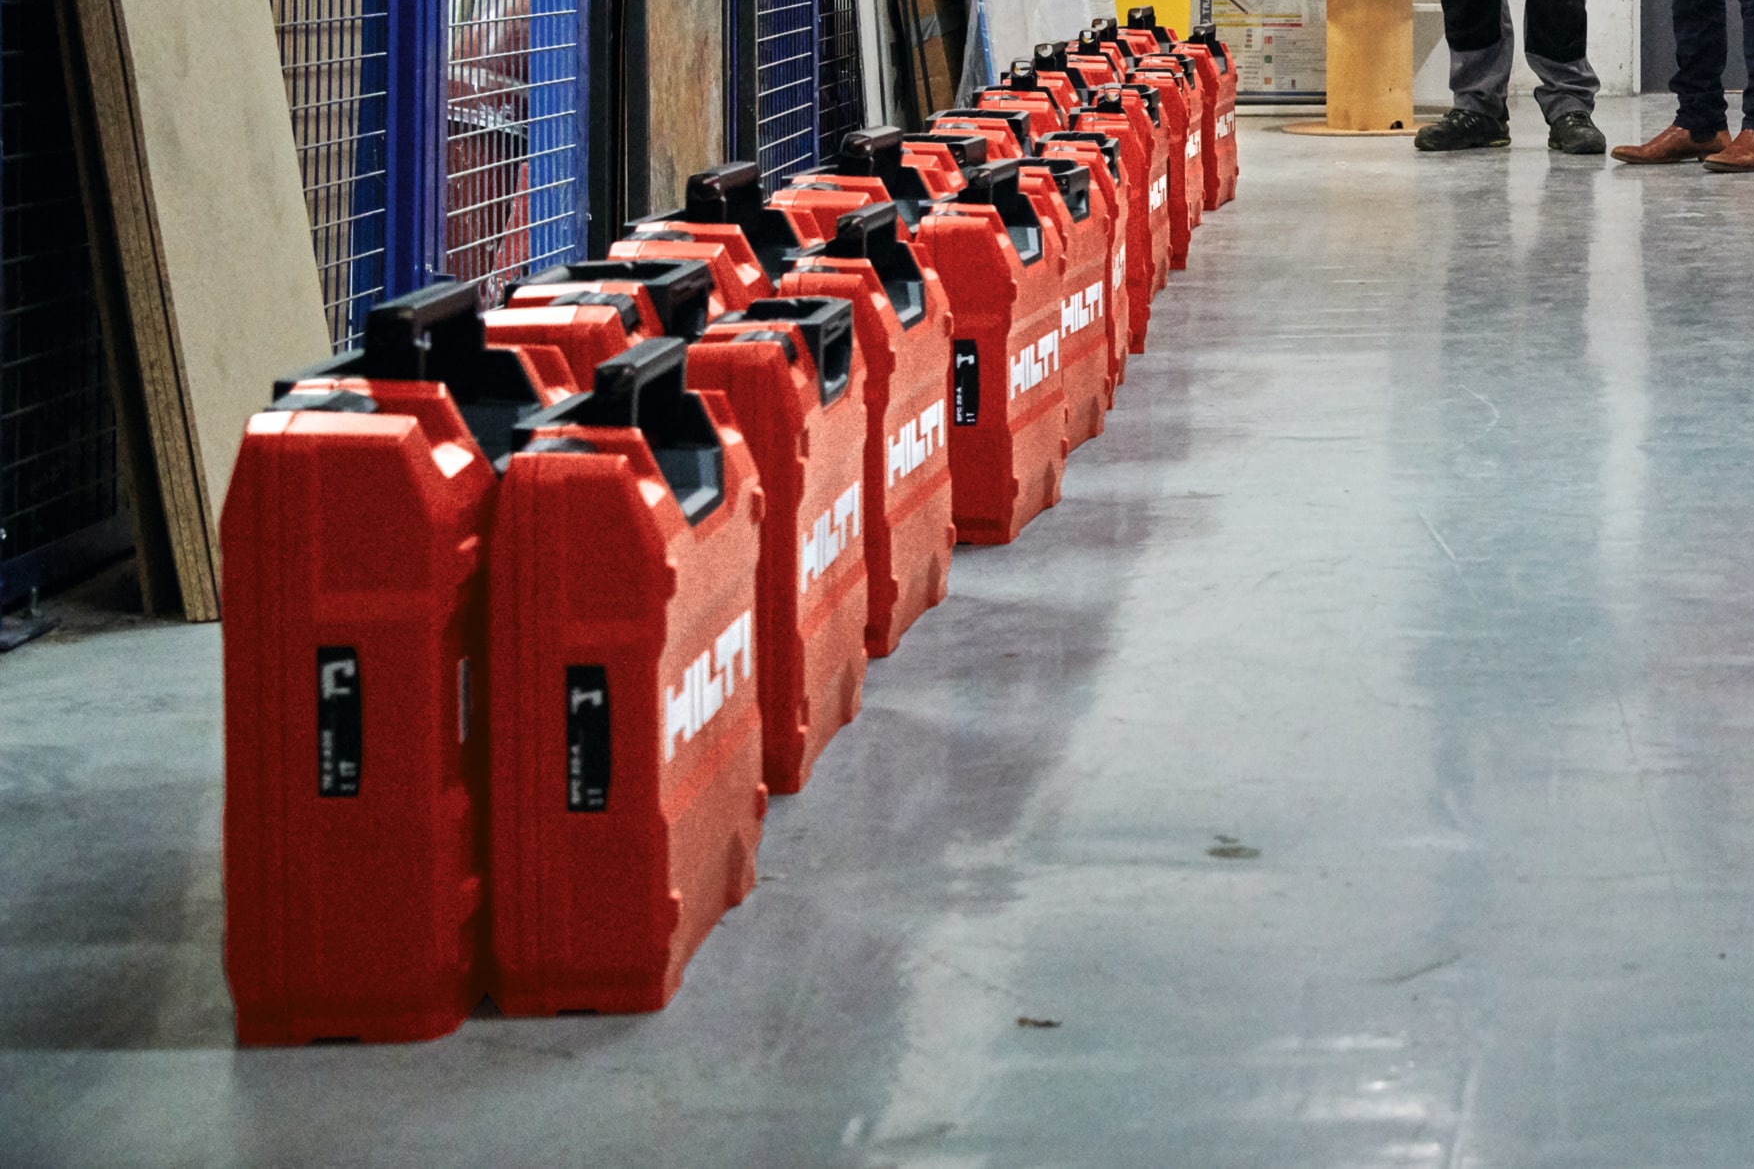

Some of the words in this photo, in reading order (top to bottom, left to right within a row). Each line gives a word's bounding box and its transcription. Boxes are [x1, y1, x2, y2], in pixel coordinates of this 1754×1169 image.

[1214, 110, 1235, 141] HILTI
[1061, 280, 1103, 339] HILTI
[1010, 329, 1060, 400] HILTI
[888, 398, 945, 489] HILTI
[802, 480, 861, 595] HILTI
[665, 609, 752, 764] HILTI
